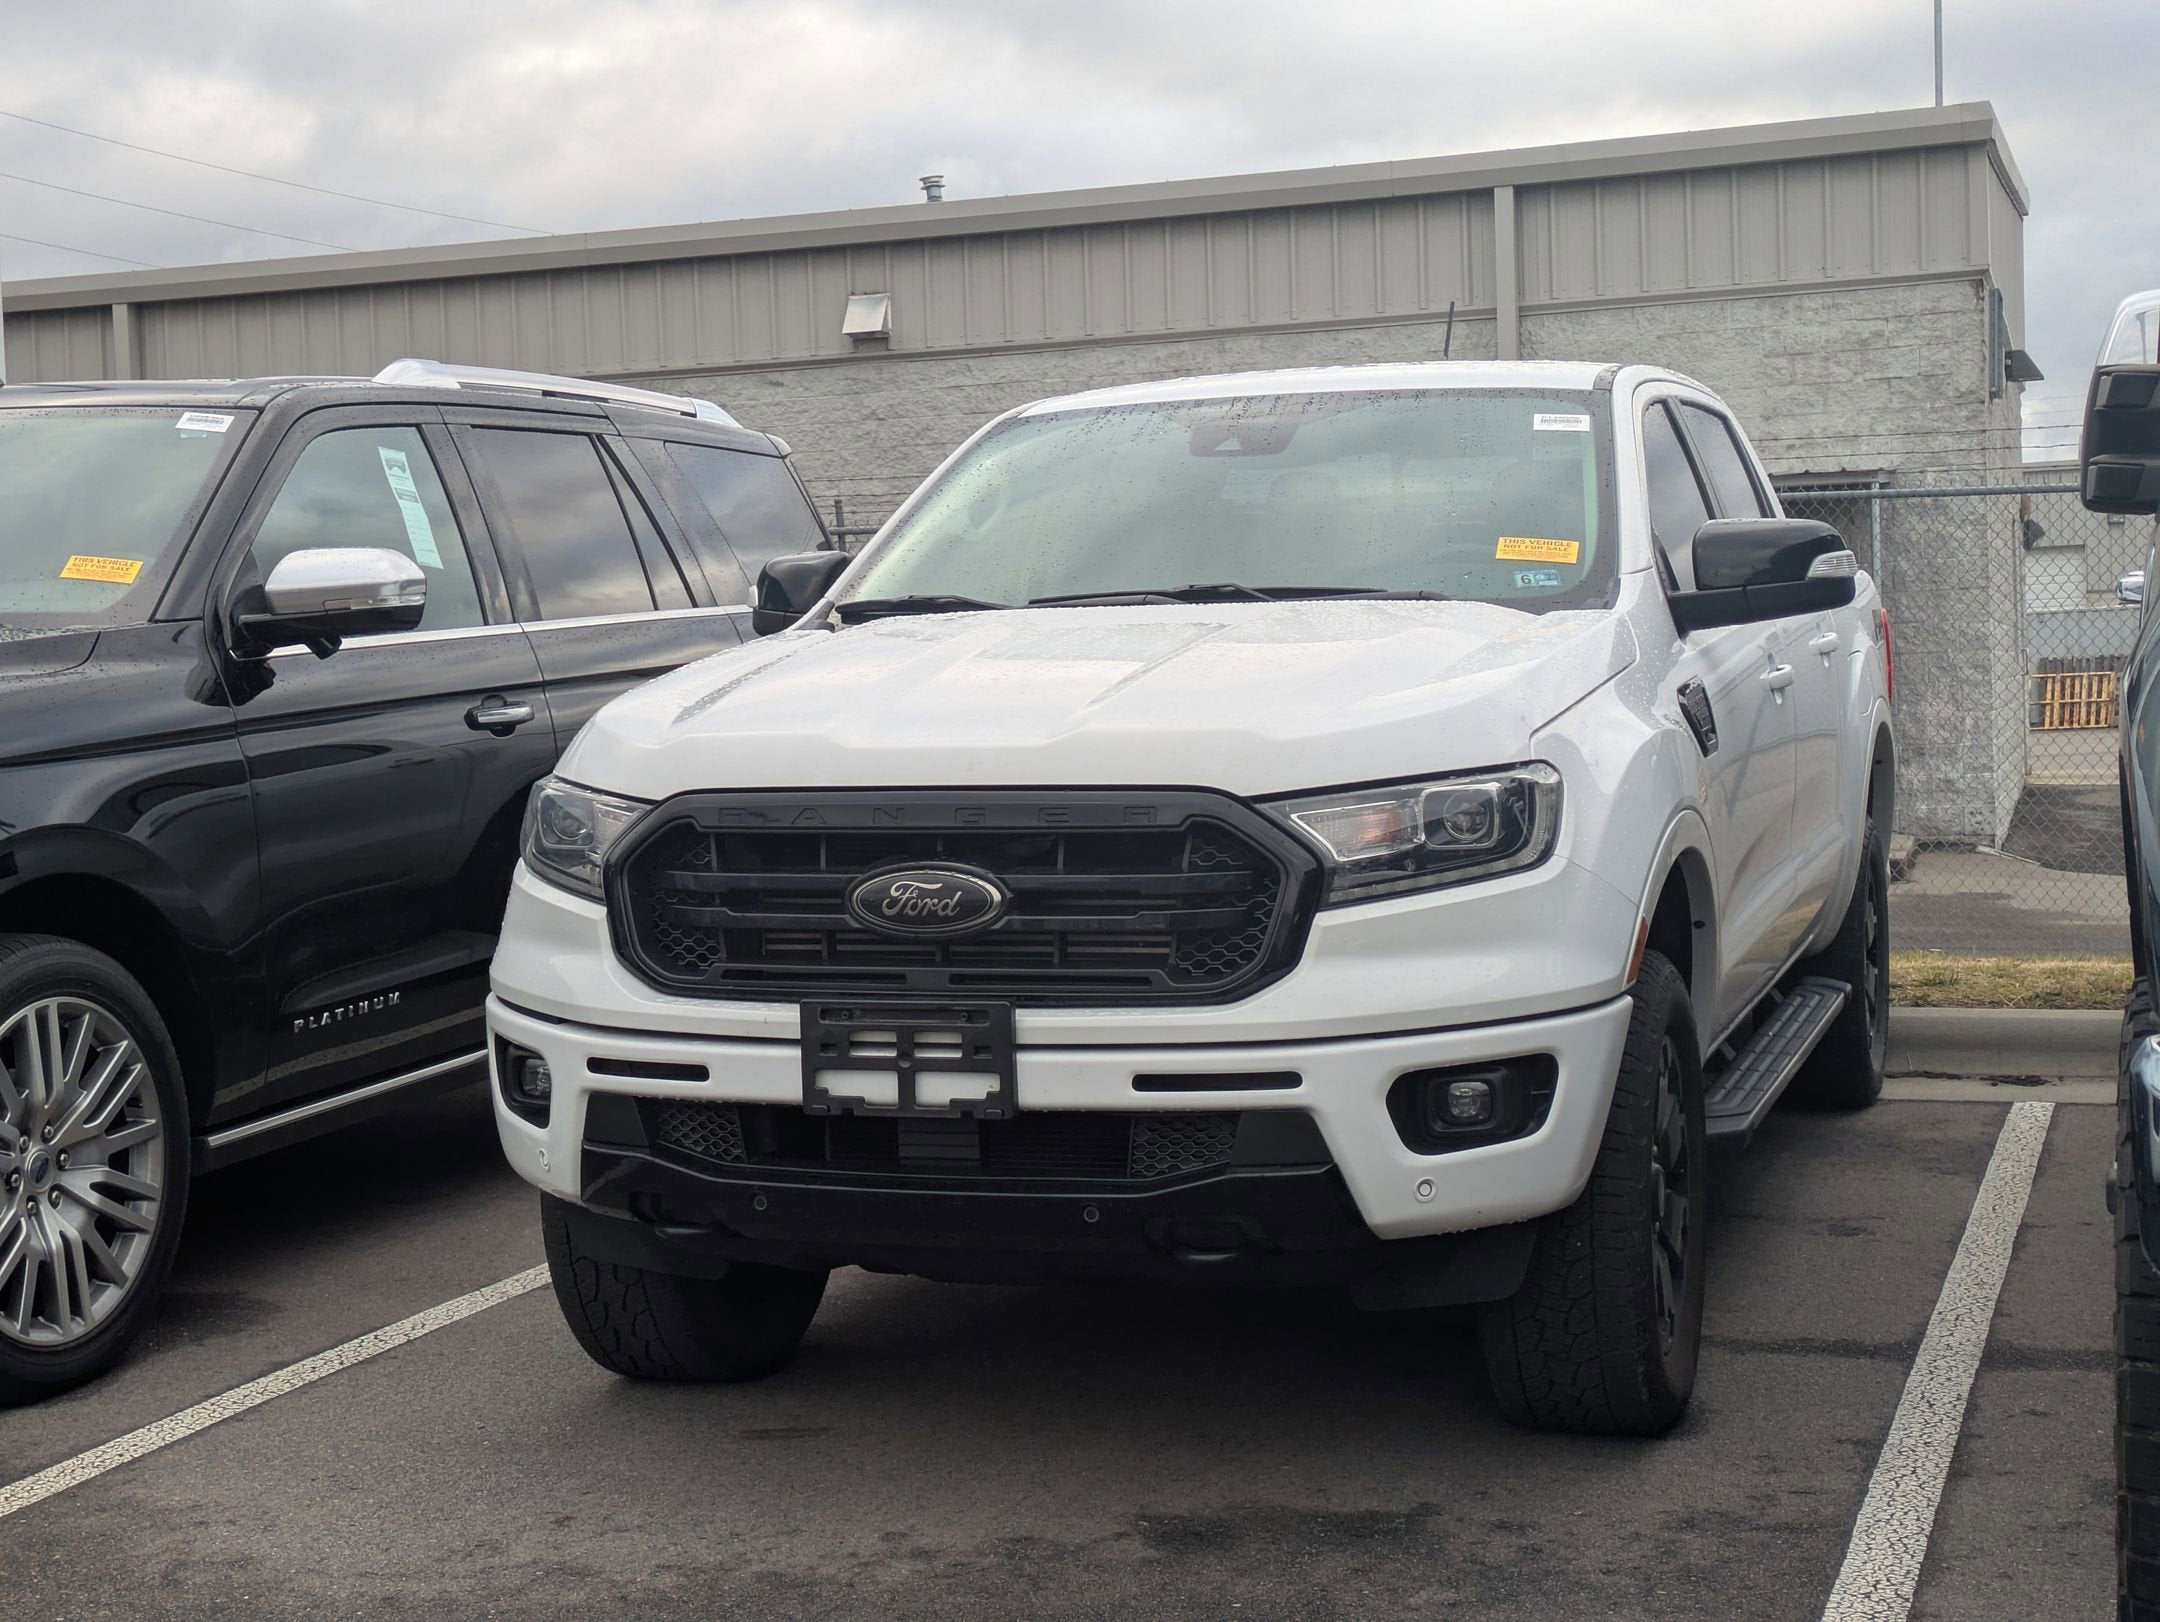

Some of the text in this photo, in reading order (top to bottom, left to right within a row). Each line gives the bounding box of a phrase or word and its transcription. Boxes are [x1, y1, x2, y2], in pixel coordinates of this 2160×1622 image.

[1529, 539, 1573, 548] VEHICLE
[96, 559, 138, 567] VEHICLE
[1520, 574, 1532, 585] 6
[718, 806, 1157, 825] RANGER
[881, 881, 962, 916] Ford
[293, 991, 400, 1034] PLATINUM
